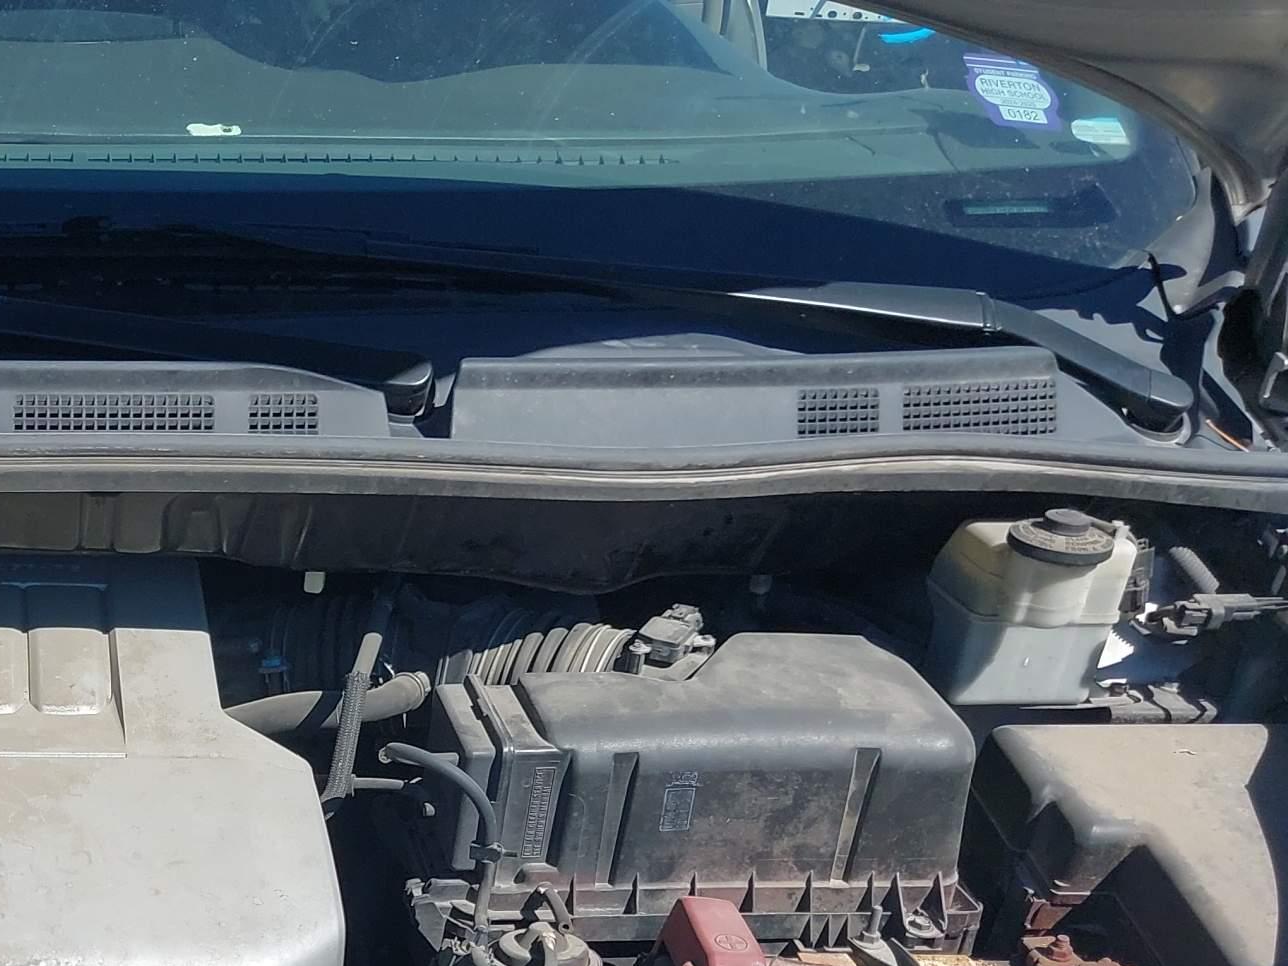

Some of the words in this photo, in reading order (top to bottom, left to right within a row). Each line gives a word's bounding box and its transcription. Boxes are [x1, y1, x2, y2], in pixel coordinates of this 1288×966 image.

[980, 77, 1042, 92] RIVERTON
[981, 87, 1006, 97] HIGH
[1007, 89, 1046, 101] SCHOOL
[1007, 109, 1040, 121] 0182
